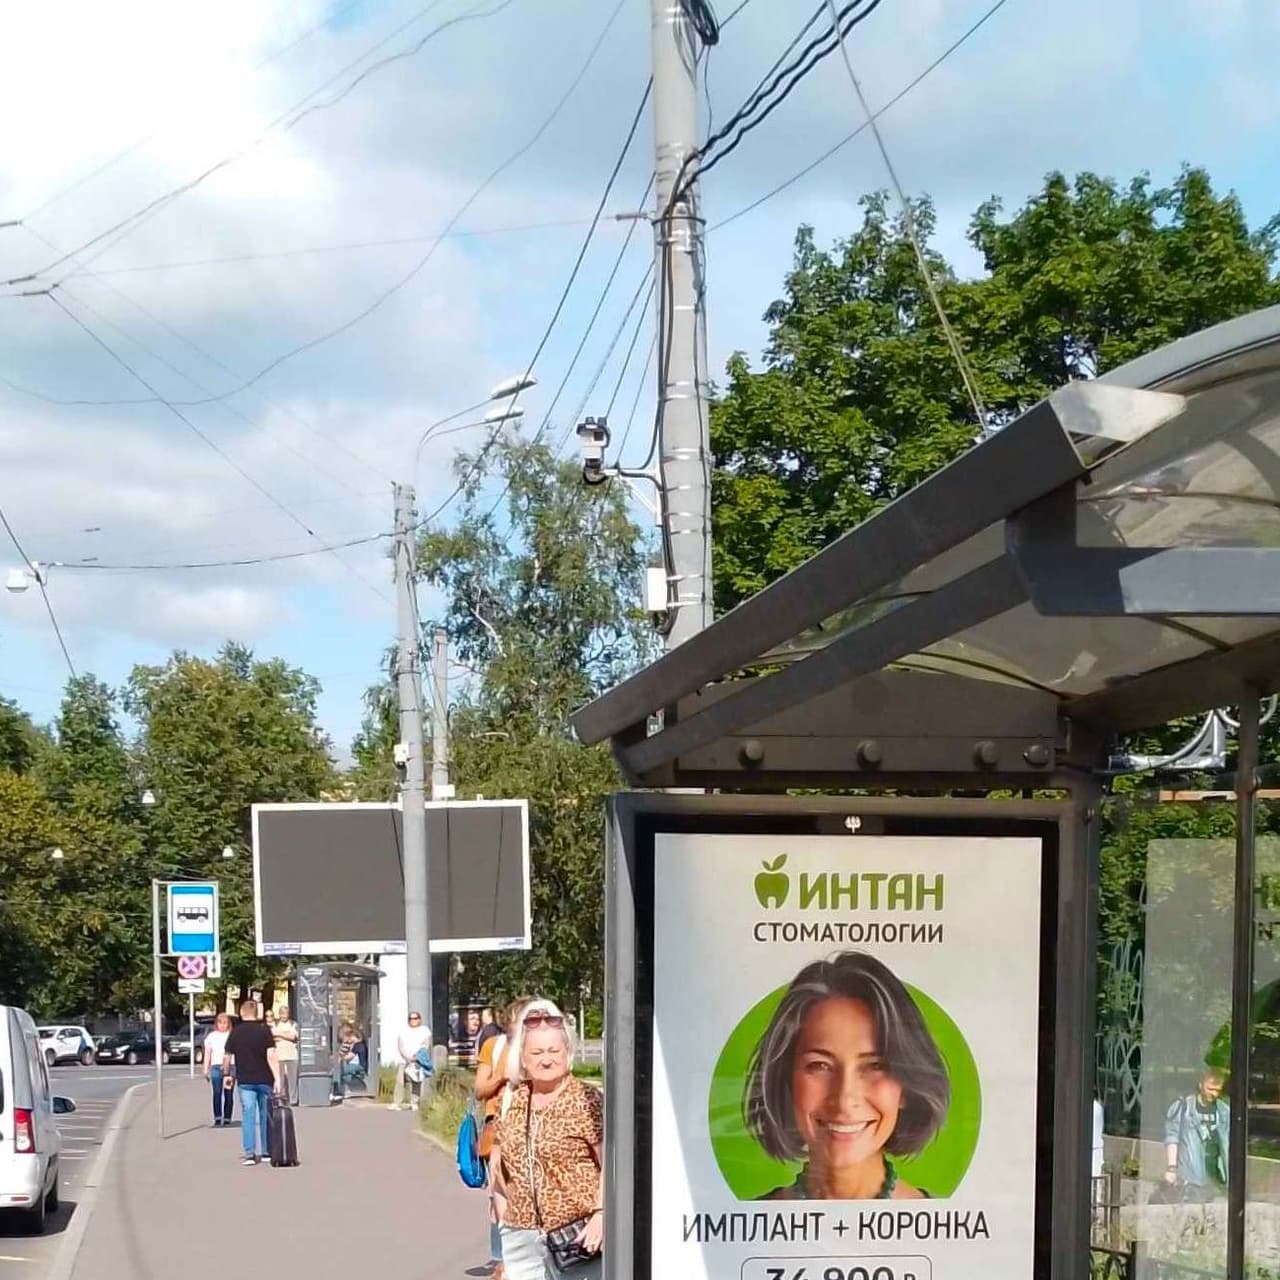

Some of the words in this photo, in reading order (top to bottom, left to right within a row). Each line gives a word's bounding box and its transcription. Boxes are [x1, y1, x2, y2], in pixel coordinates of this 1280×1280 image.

[799, 872, 944, 911] ИНТАН
[753, 922, 944, 944] СТОМАТОЛОГИИ
[683, 1211, 825, 1242] ИМПЛАНТ
[832, 1219, 850, 1238] +
[858, 1210, 990, 1240] КОРОНКА
